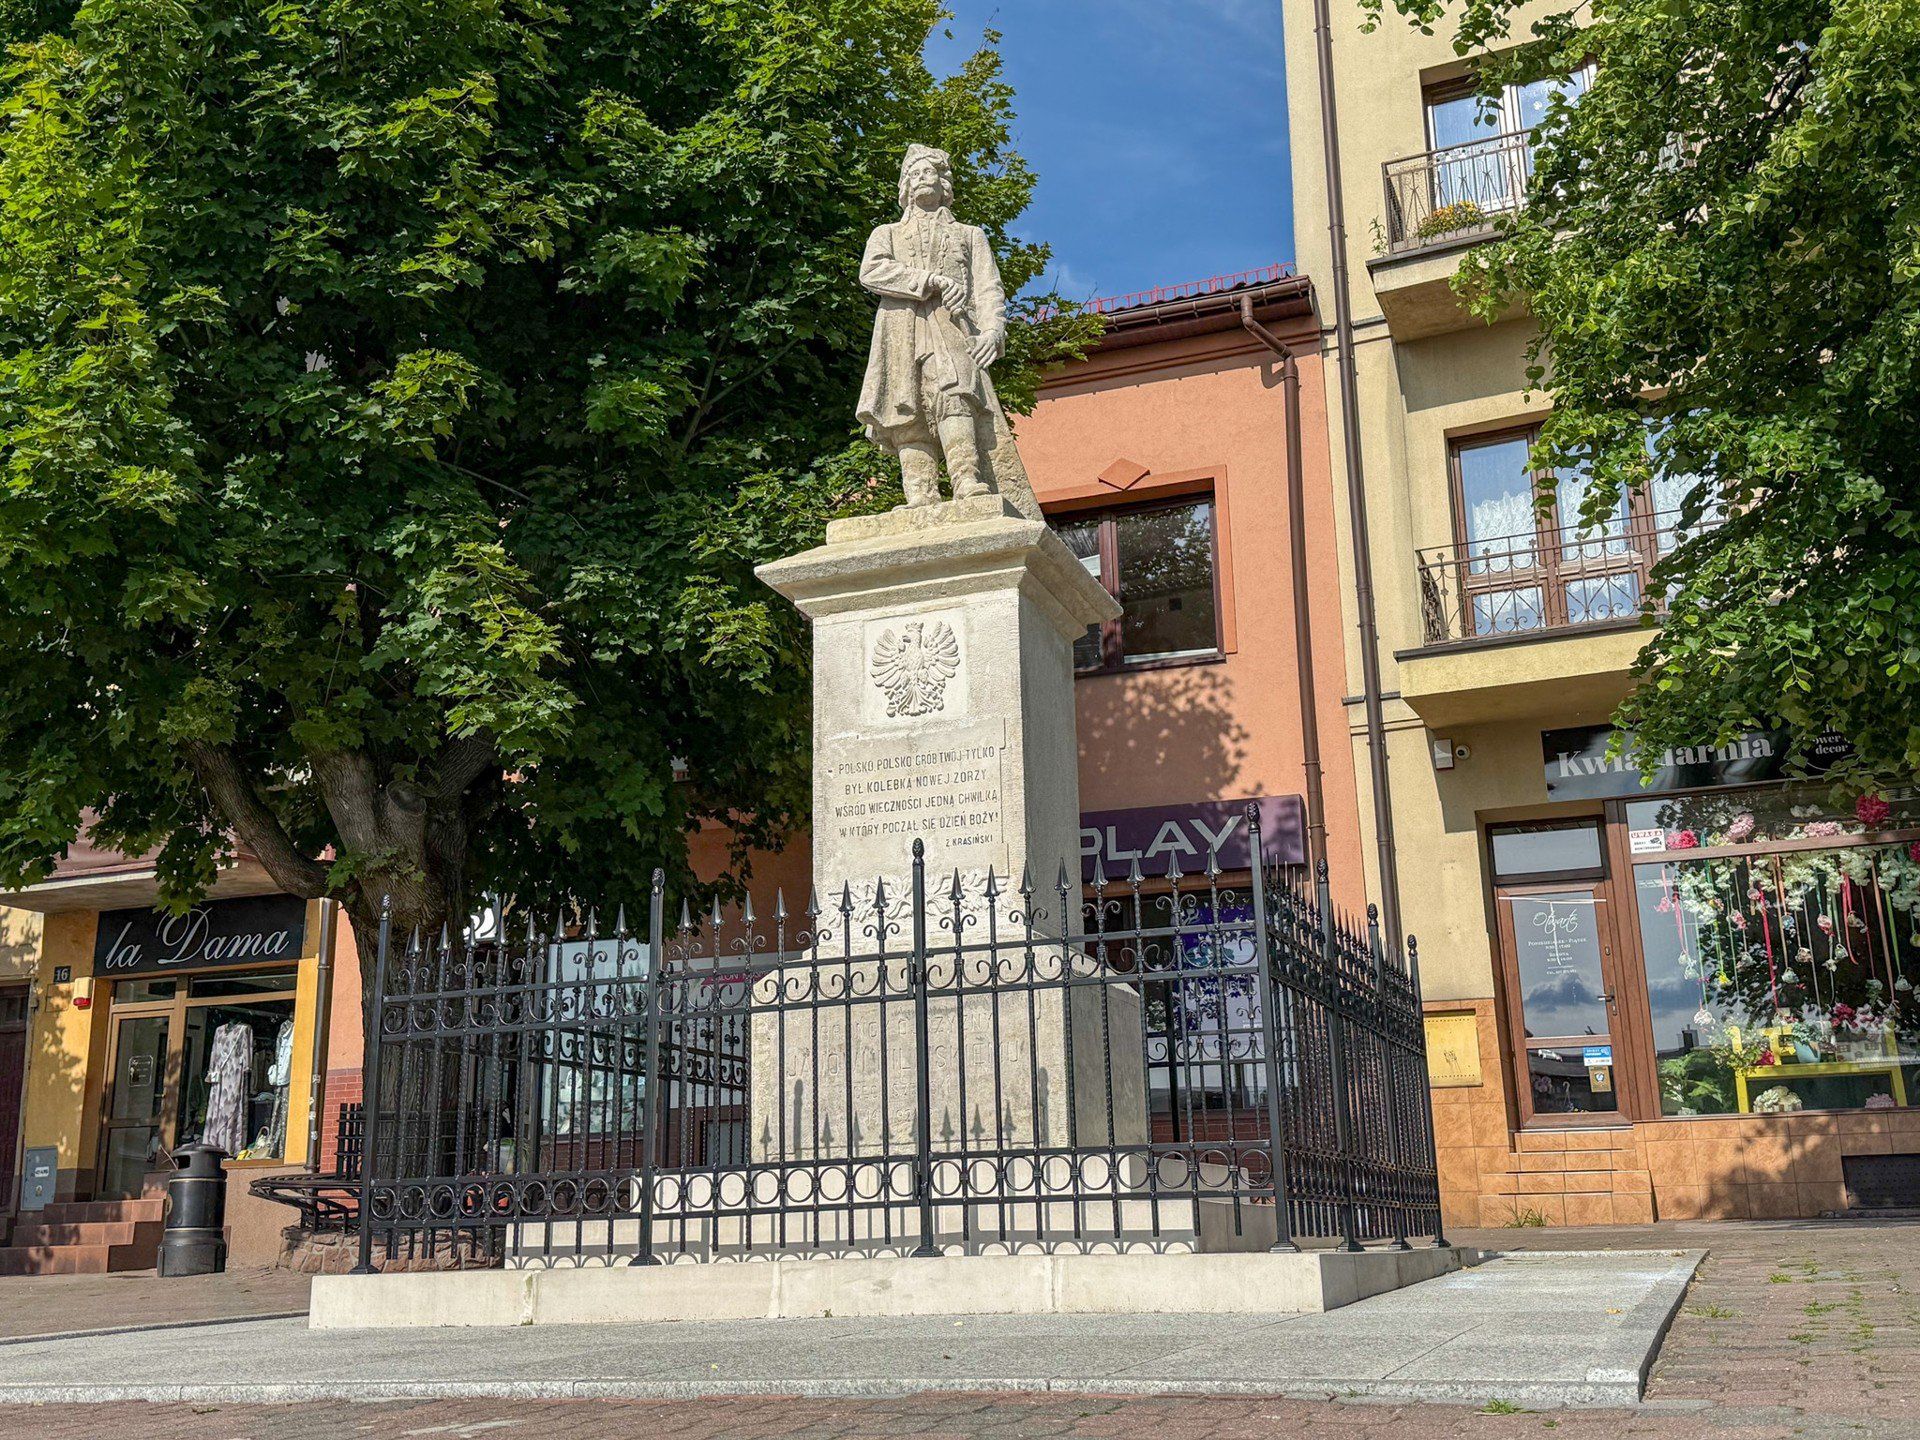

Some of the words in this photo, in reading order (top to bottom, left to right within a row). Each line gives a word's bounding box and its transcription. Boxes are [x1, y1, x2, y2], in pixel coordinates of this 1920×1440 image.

[877, 755, 912, 770] POLSKO
[915, 750, 938, 766] GRÓB
[966, 746, 995, 760] TYLKO
[1815, 744, 1849, 755] decor
[845, 783, 864, 795] BYŁ
[866, 777, 912, 793] KOLEBKĄ
[916, 773, 950, 788] NOWEJ
[953, 769, 987, 784] ZORZY
[835, 801, 866, 818] WŚRÓD
[868, 795, 922, 814] WIECZNOŚCI
[925, 794, 955, 808] JEDNĄ
[839, 827, 847, 838] W
[939, 810, 967, 829] DZIEŃ
[969, 811, 998, 826] BOŻY!
[952, 833, 993, 847] KRASIŃSKI
[1080, 815, 1243, 861] PLAY
[105, 921, 143, 970] la
[155, 905, 290, 965] Dama
[55, 968, 68, 982] 16
